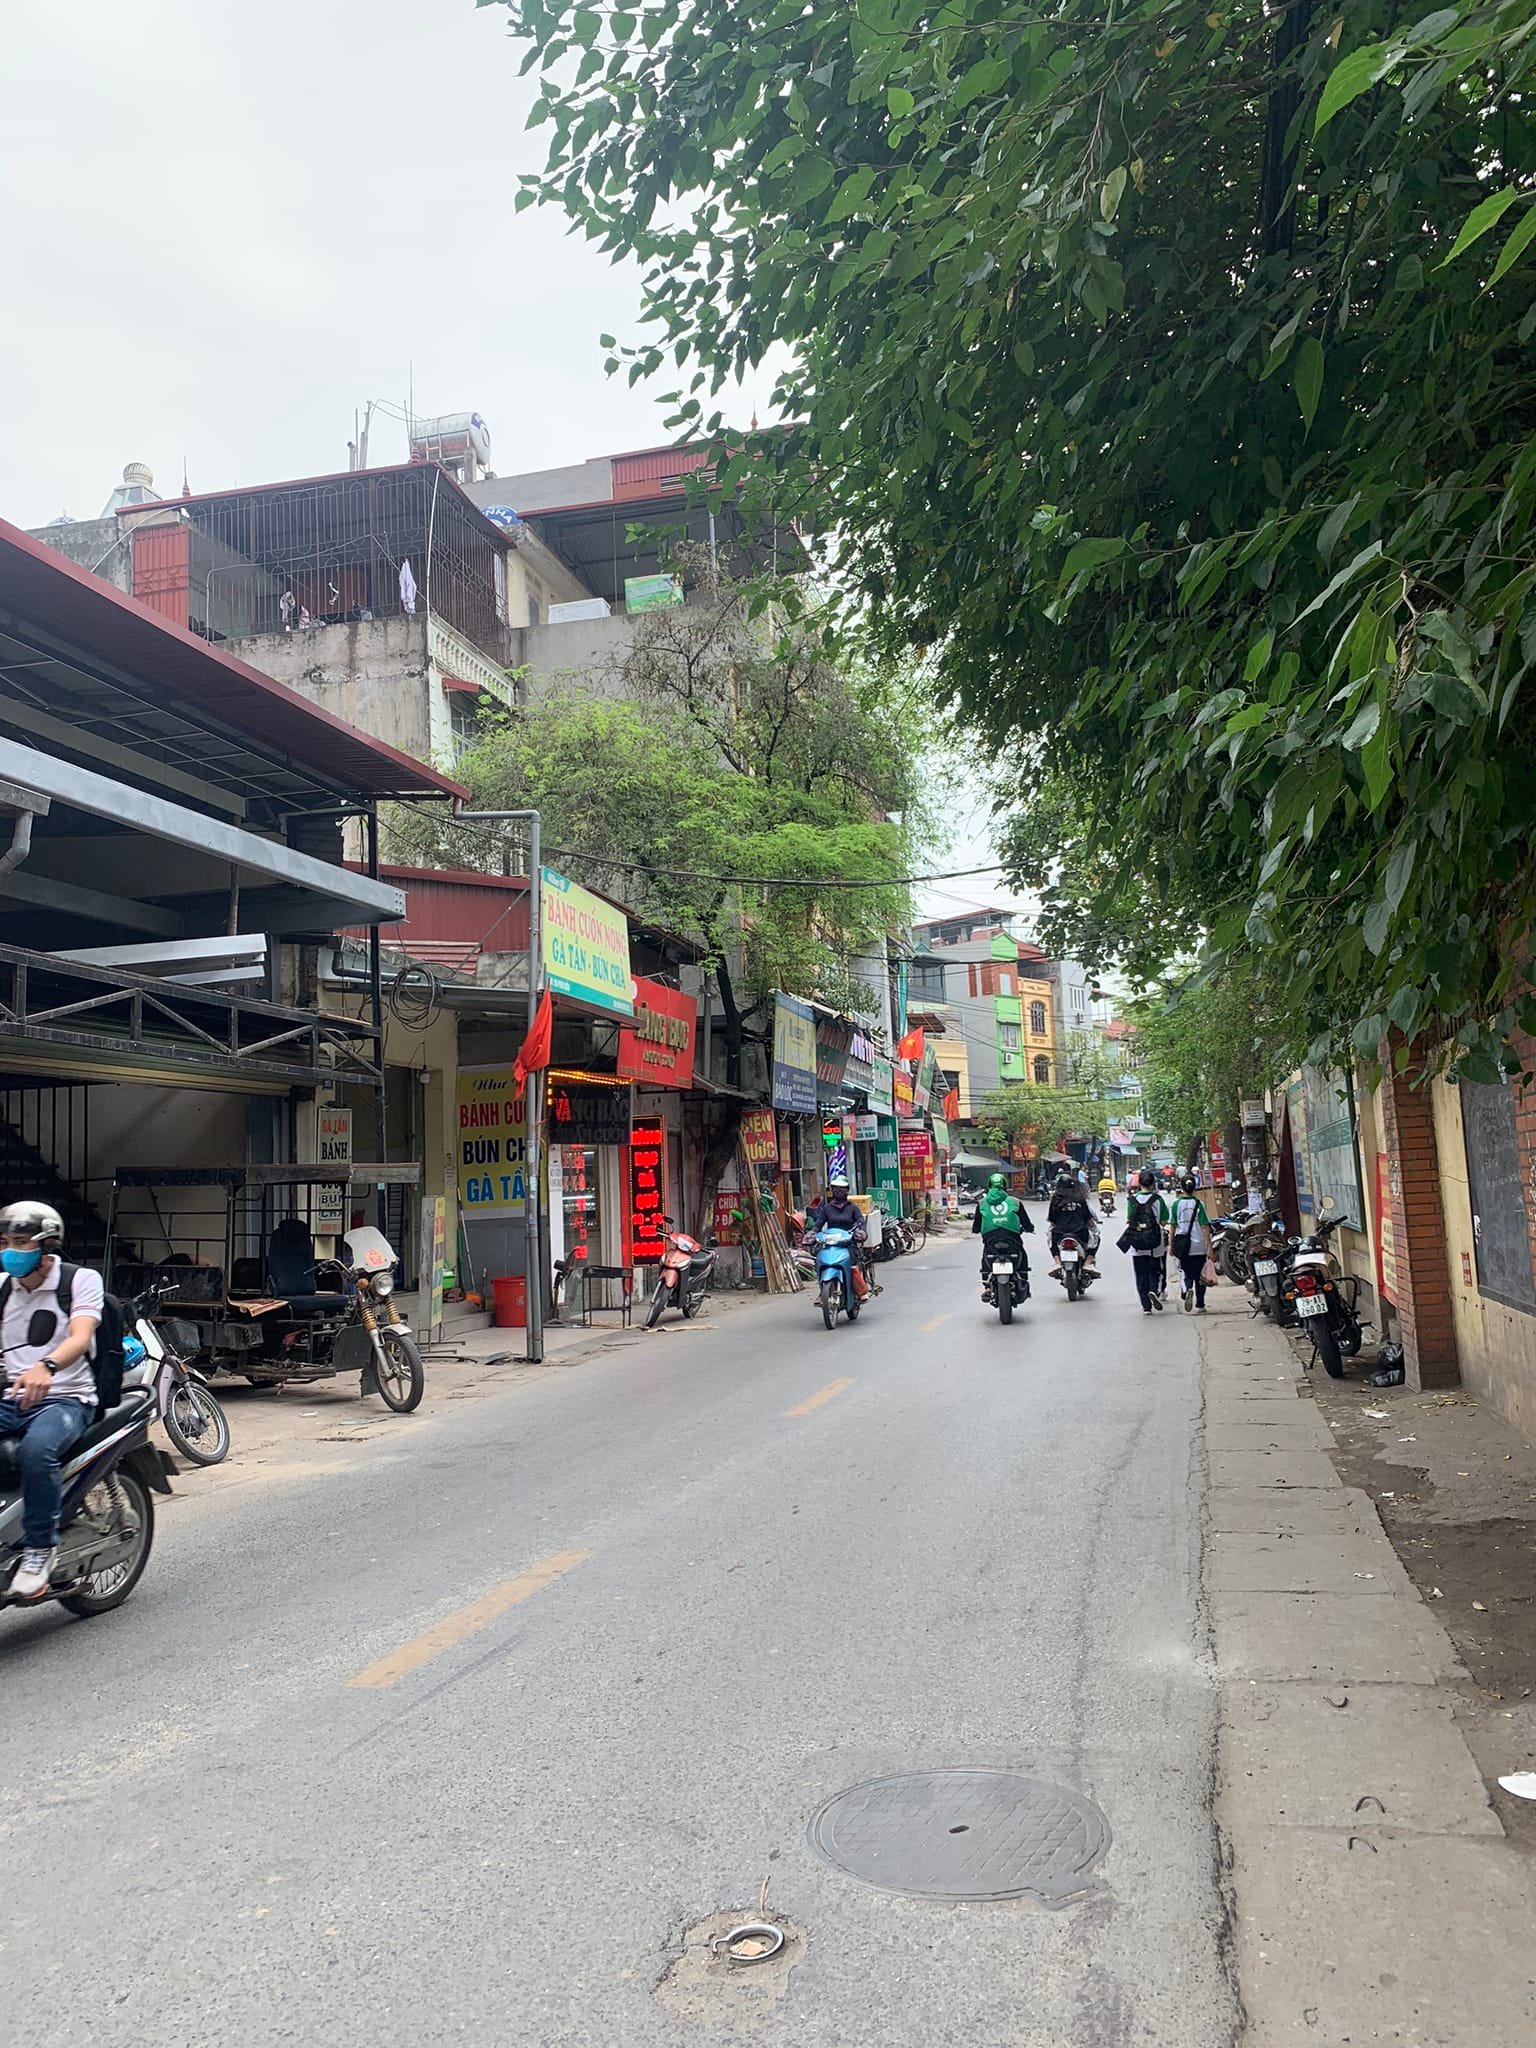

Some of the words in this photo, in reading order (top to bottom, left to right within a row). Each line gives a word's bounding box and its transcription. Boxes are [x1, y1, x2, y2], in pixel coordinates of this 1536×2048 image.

[547, 891, 577, 936] BÁNH
[578, 908, 603, 945] CUỐN
[552, 933, 566, 966] GÀ
[592, 951, 609, 983] BÚN
[460, 1099, 499, 1128] BÁNH
[504, 1101, 527, 1125] CU
[321, 1137, 348, 1160] BÁNH
[463, 1135, 500, 1165] BÚN
[467, 1171, 494, 1203] GÀ
[500, 1167, 526, 1200] TẦ
